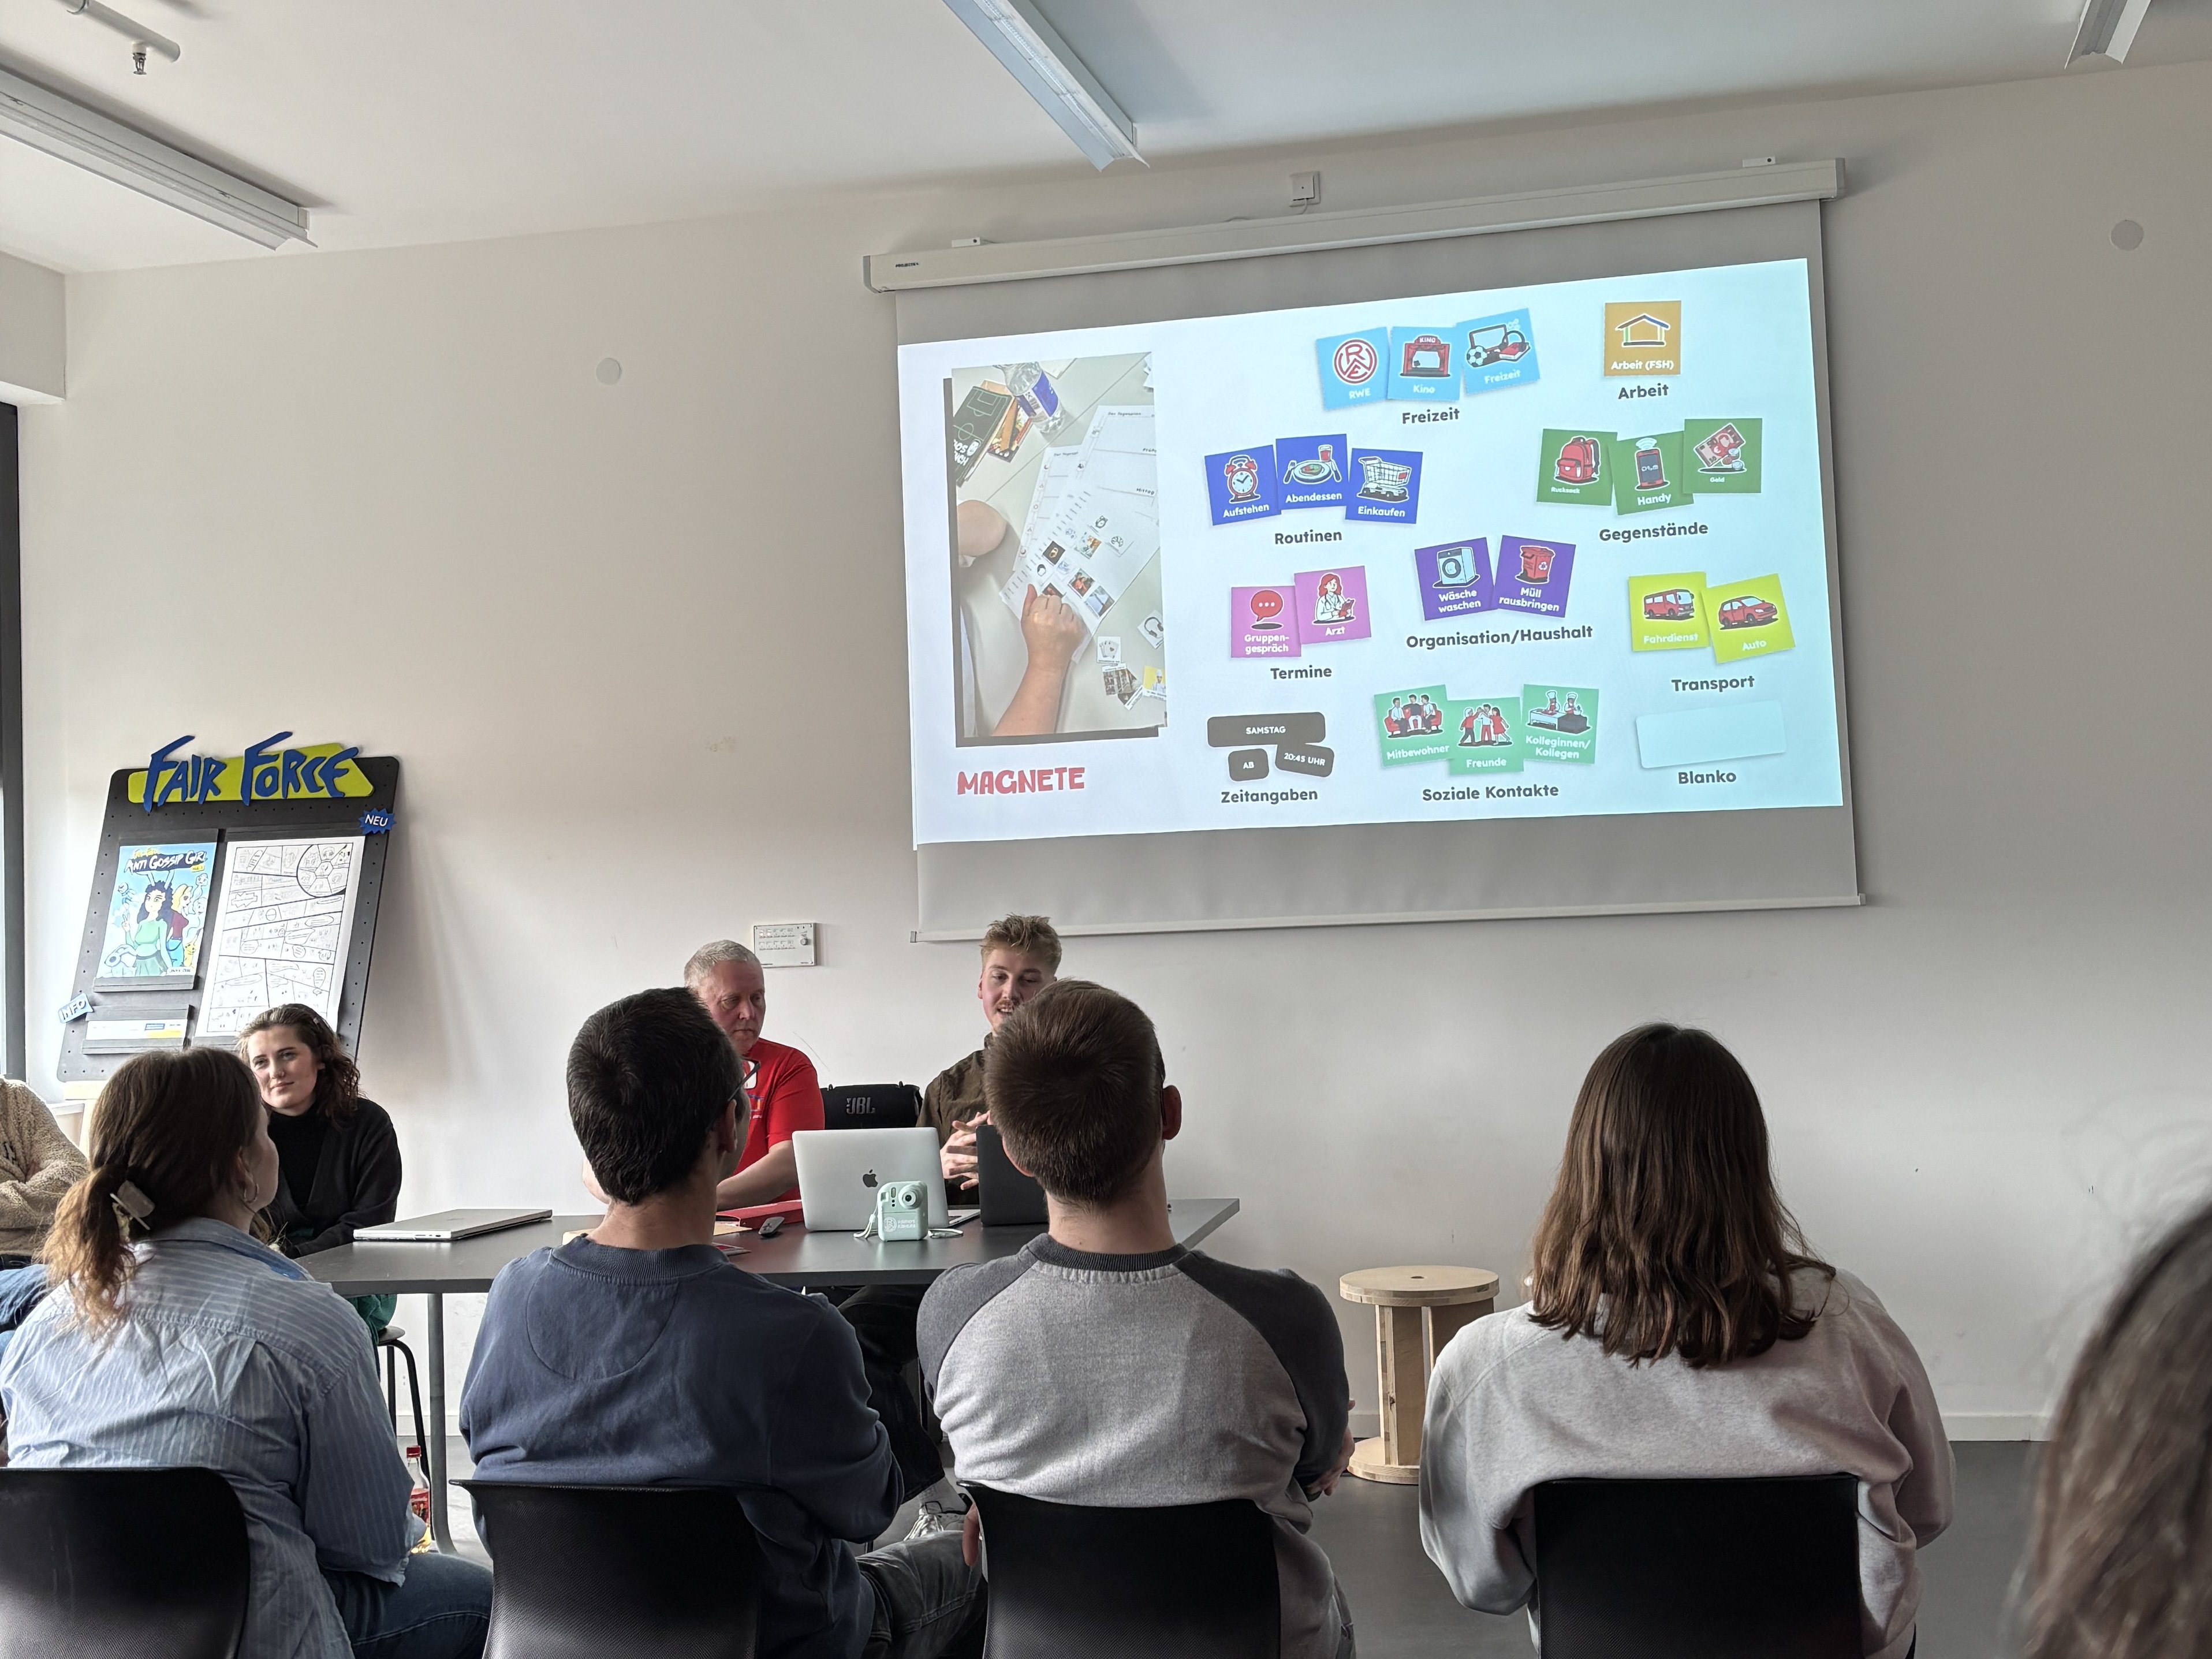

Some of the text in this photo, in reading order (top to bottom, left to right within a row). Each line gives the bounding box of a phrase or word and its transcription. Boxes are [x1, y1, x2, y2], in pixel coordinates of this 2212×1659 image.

[1611, 360, 1674, 370] Arbeit (FSH)
[1484, 369, 1521, 384] Freizeit
[1349, 388, 1371, 399] RWE
[1413, 385, 1435, 394] Kino
[1618, 383, 1669, 399] Arbeit
[1402, 407, 1460, 424] Freizeit
[1285, 493, 1342, 504] Abendessen
[1637, 493, 1672, 506] Handy
[1223, 504, 1269, 518] Aufstehen
[1357, 506, 1405, 517] Einkaufen
[1274, 530, 1342, 545] Routinen
[1599, 522, 1709, 543] Gegenstände
[1439, 589, 1477, 602] Wäsche
[1520, 587, 1542, 598] Müll
[1438, 600, 1481, 613] waschen
[1499, 597, 1560, 612] rausbringen
[1325, 627, 1345, 636] Arzt
[1406, 625, 1594, 650] Organisation/Haushalt
[1643, 633, 1698, 644] Fahrdienst
[1244, 634, 1289, 644] Gruppen-
[1742, 639, 1767, 651] Auto
[1245, 643, 1289, 655] gespräch
[1270, 665, 1332, 680] Termine
[1671, 675, 1755, 692] Transport
[1245, 726, 1286, 735] SAMSTAG
[1525, 735, 1591, 750] Kolleginnen/
[1387, 744, 1450, 760] Mitbewohner
[1535, 747, 1580, 759] Kollegen
[1308, 757, 1326, 766] UHR
[1466, 758, 1506, 768] Freunde
[143, 731, 359, 812] FAIR FORCE
[1678, 769, 1737, 784] Blanko
[957, 767, 1086, 795] MAGNETE
[1221, 789, 1318, 804] Zeitangaben
[1422, 784, 1560, 801] Soziale Kontakte
[365, 815, 389, 826] NEU
[124, 850, 208, 875] ANTI GOSSIP GIRL
[59, 999, 86, 1020] INFO
[846, 1097, 875, 1114] JBL
